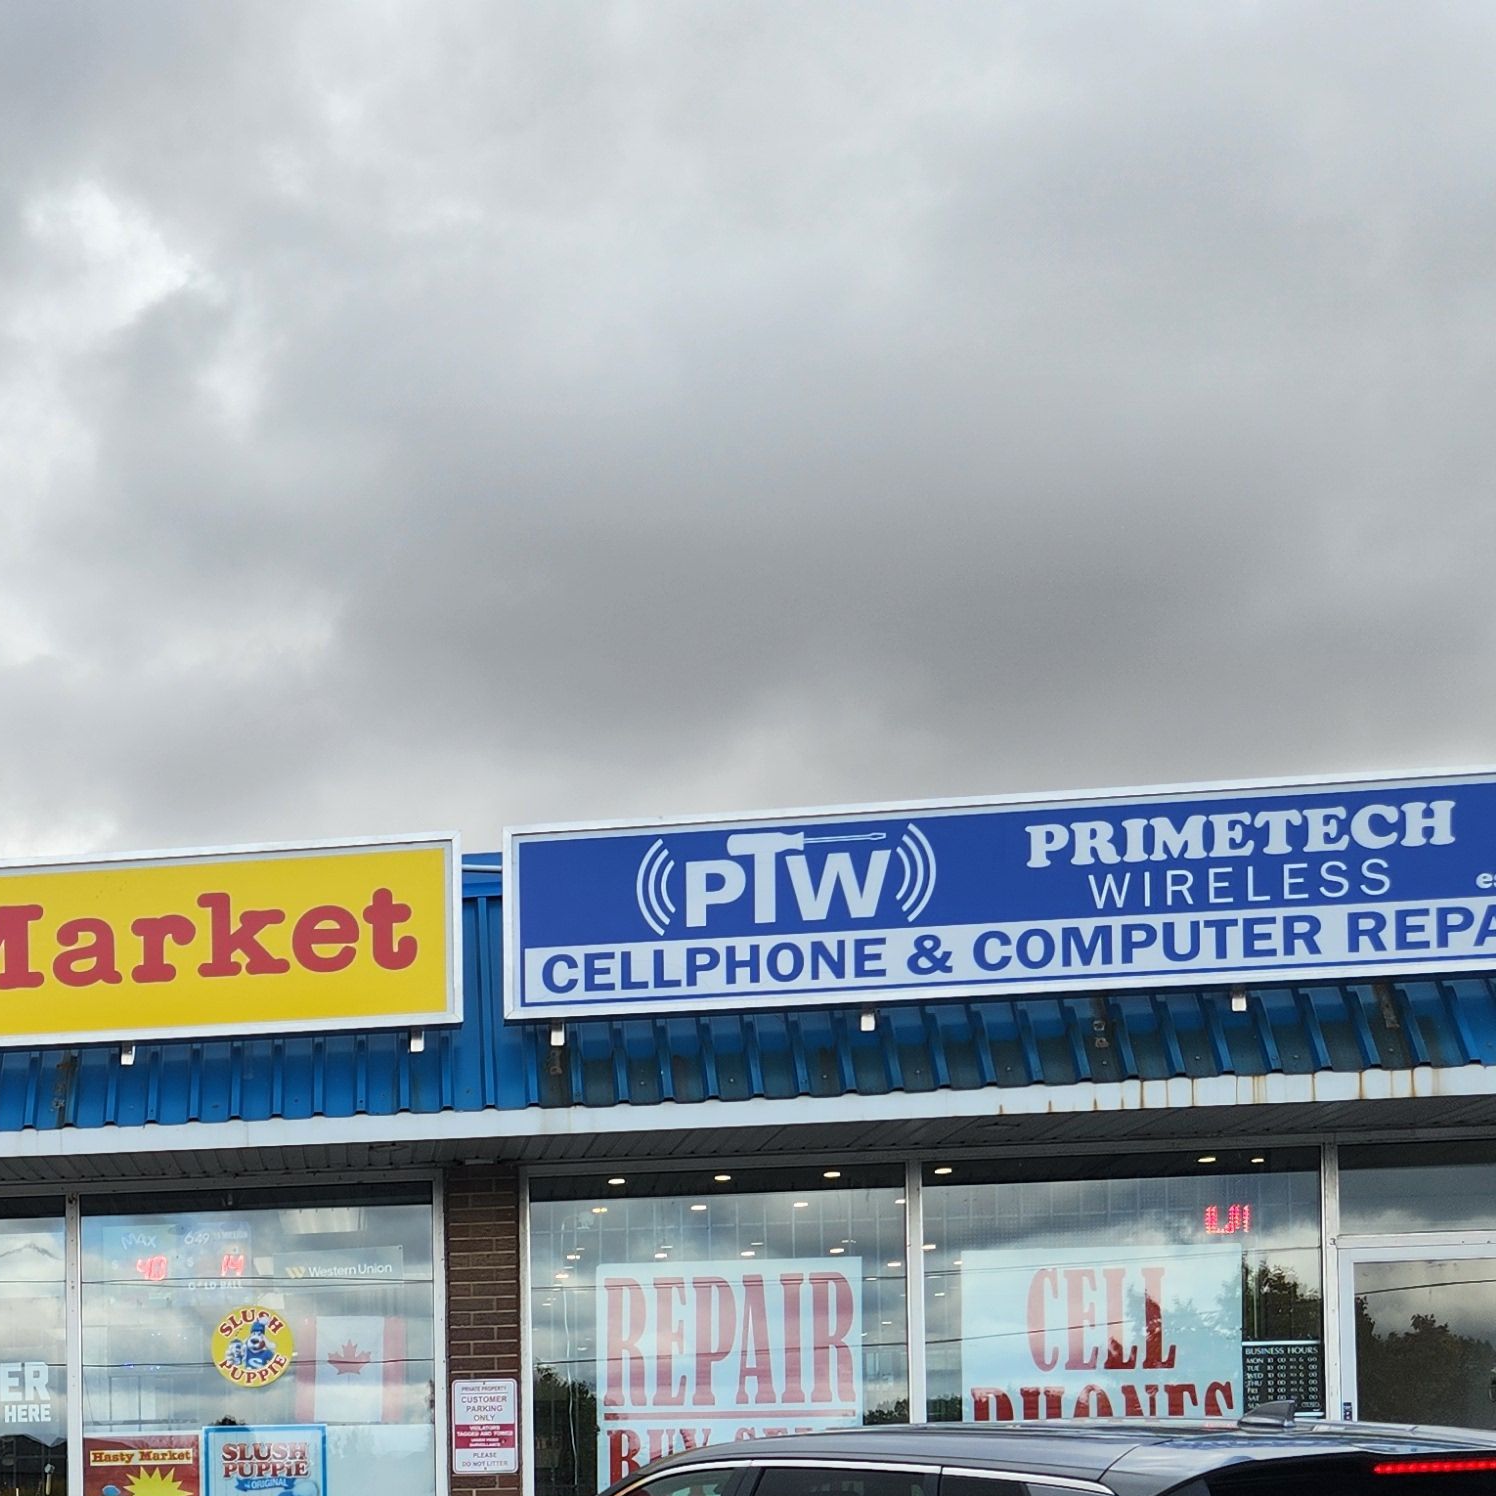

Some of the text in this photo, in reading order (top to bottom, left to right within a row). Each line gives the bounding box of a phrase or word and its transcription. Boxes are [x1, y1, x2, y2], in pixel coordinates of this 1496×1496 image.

[1025, 800, 1456, 868] PRIMETECH
[685, 831, 892, 928] PTW
[1088, 858, 1391, 909] WIRELESS
[541, 937, 888, 994] CELLPHONE
[906, 934, 953, 976] &
[973, 914, 1323, 971] COMPUTER
[184, 1231, 210, 1245] 649
[308, 1264, 393, 1276] Western Union
[1027, 1267, 1177, 1373] CELL
[603, 1271, 857, 1407] REPAIR
[1287, 1346, 1319, 1354] HOURS
[461, 1395, 507, 1403] CUSTOMER
[466, 1404, 503, 1412] PARKING
[4, 1404, 51, 1423] HERE
[92, 1449, 191, 1463] Hasty Market
[222, 1442, 308, 1461] SLUSH
[251, 1478, 289, 1489] ORIGINAL
